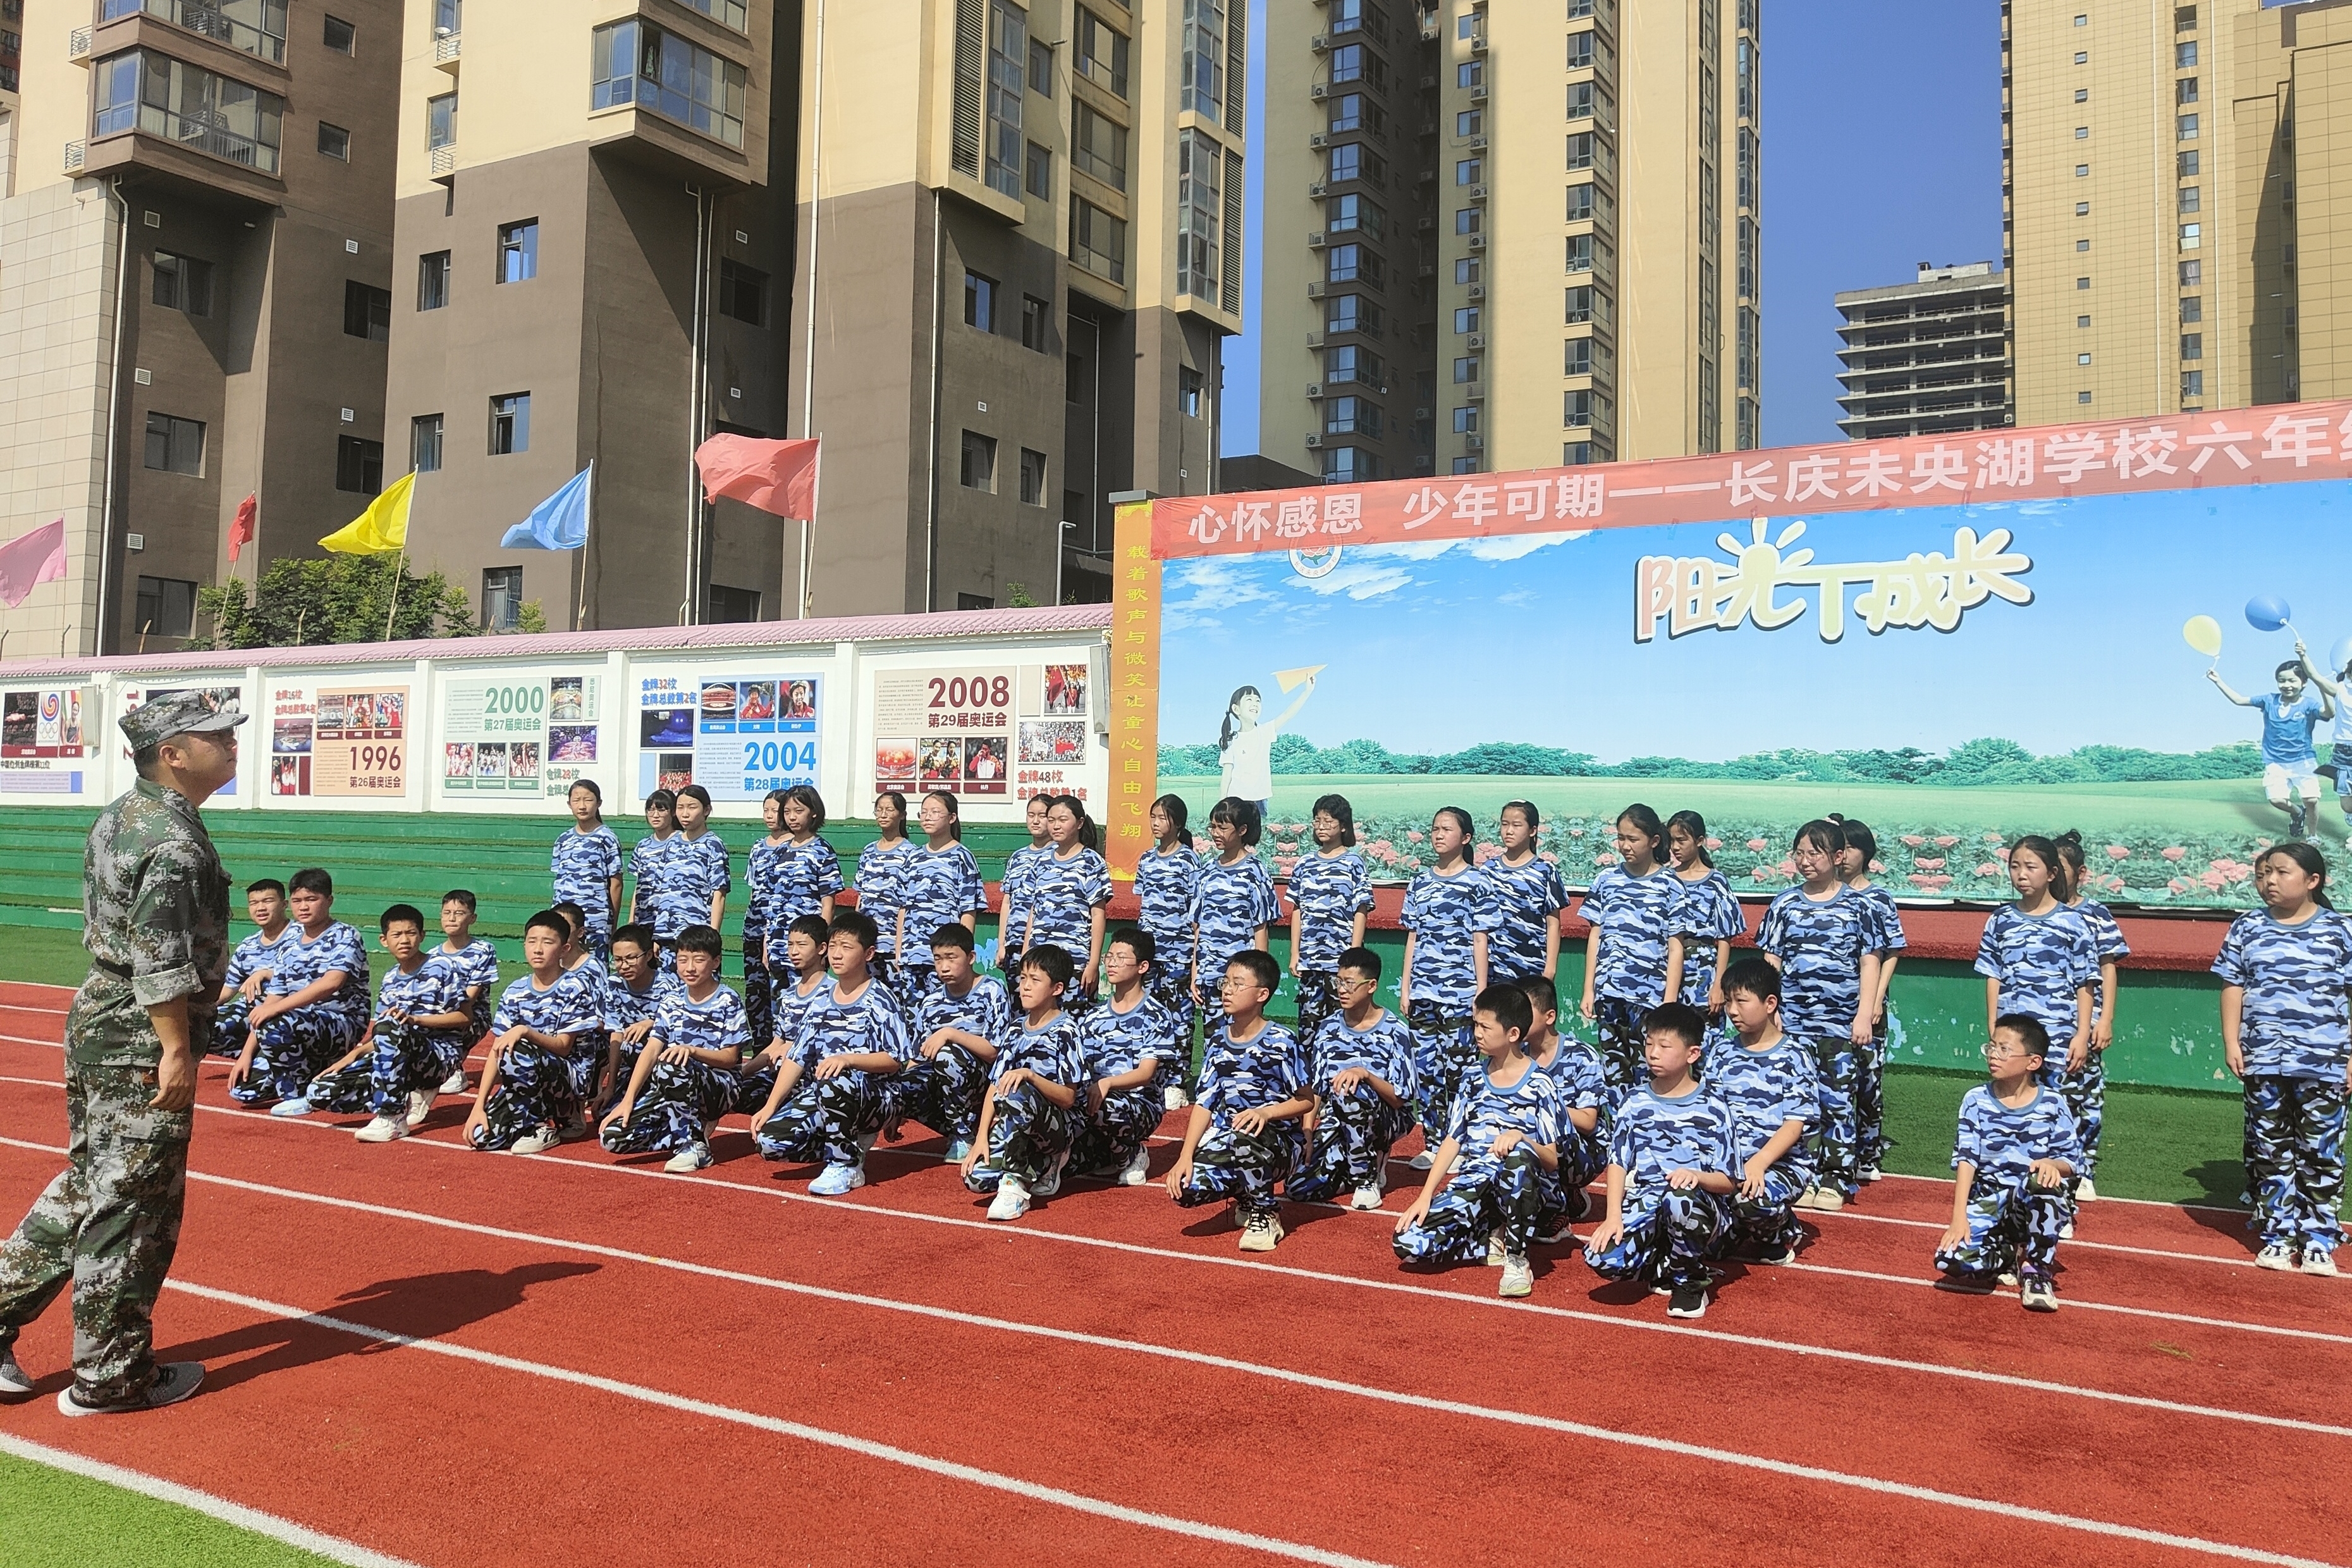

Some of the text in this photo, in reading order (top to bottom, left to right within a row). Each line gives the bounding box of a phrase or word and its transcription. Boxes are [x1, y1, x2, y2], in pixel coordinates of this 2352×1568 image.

[1188, 410, 2352, 544] 心怀感恩 少年可期——长庆未央湖学校六年
[1635, 517, 2035, 644] 阳光下成长
[641, 677, 677, 691] 金牌32枚
[928, 675, 1010, 707] 2008
[1118, 544, 1149, 838] 载着歌声与微笑让童心自由飞翔
[484, 686, 544, 713] 2000
[641, 692, 697, 706] 金牌总数第2名
[484, 718, 541, 732] 第27届奥运会
[928, 712, 1008, 728] 第29届奥运会
[350, 745, 401, 771] 1996
[744, 741, 816, 771] 2004
[350, 776, 401, 788] 第26届奥运会
[1017, 769, 1064, 783] 金牌48枚
